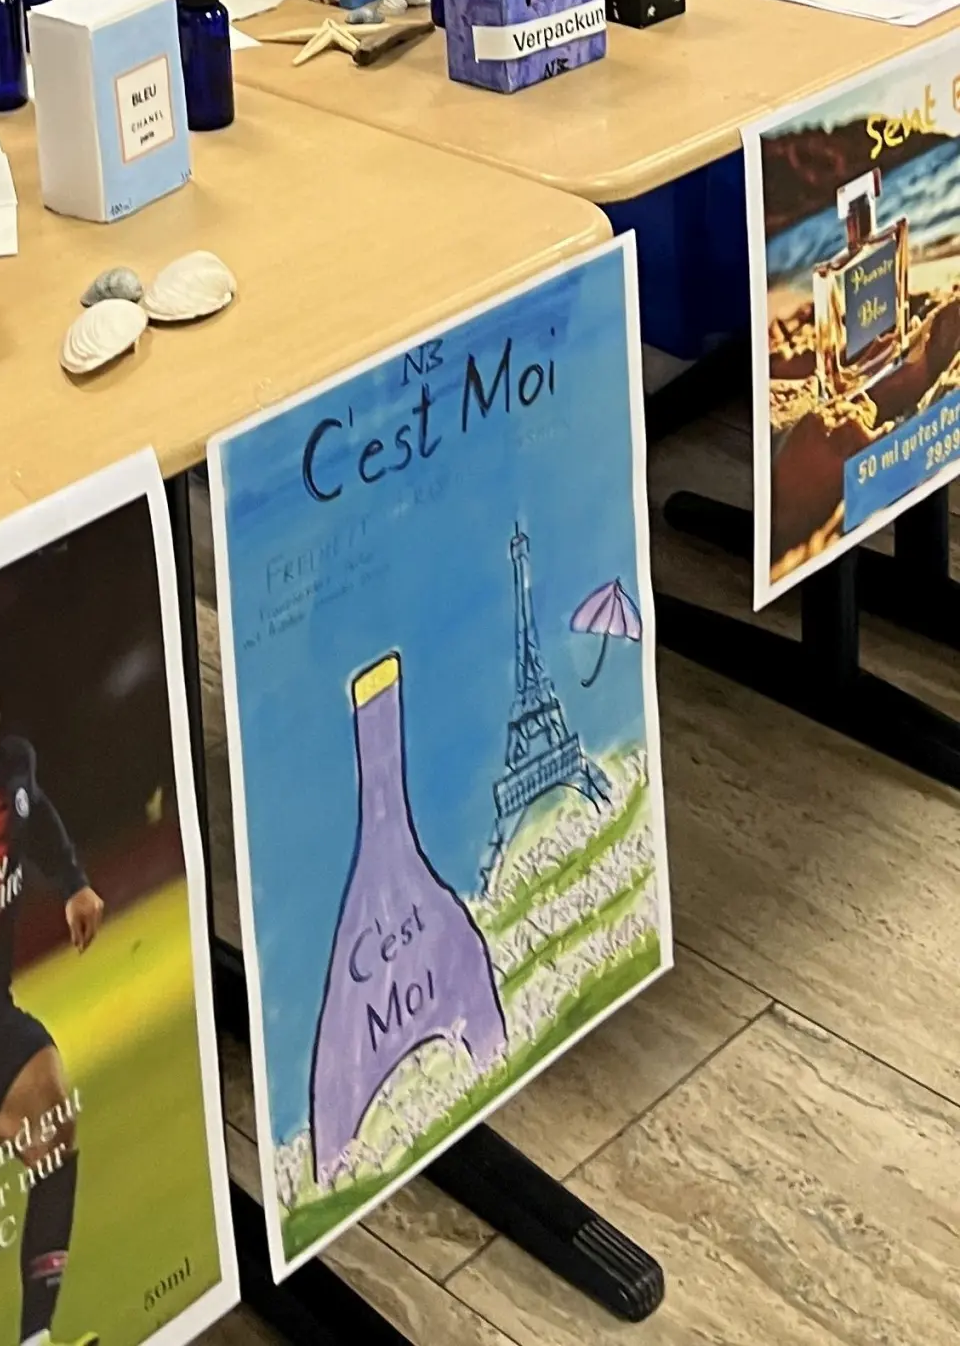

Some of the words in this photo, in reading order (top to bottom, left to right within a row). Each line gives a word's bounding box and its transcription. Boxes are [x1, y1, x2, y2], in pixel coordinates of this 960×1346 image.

[131, 83, 158, 108] BLEU
[302, 383, 443, 502] C'est
[461, 327, 557, 433] Moi
[858, 454, 877, 485] 50
[881, 439, 899, 471] ml
[348, 903, 426, 983] C'est
[366, 968, 435, 1053] Moi
[40, 1086, 83, 1142] gut
[19, 1142, 68, 1194] nur
